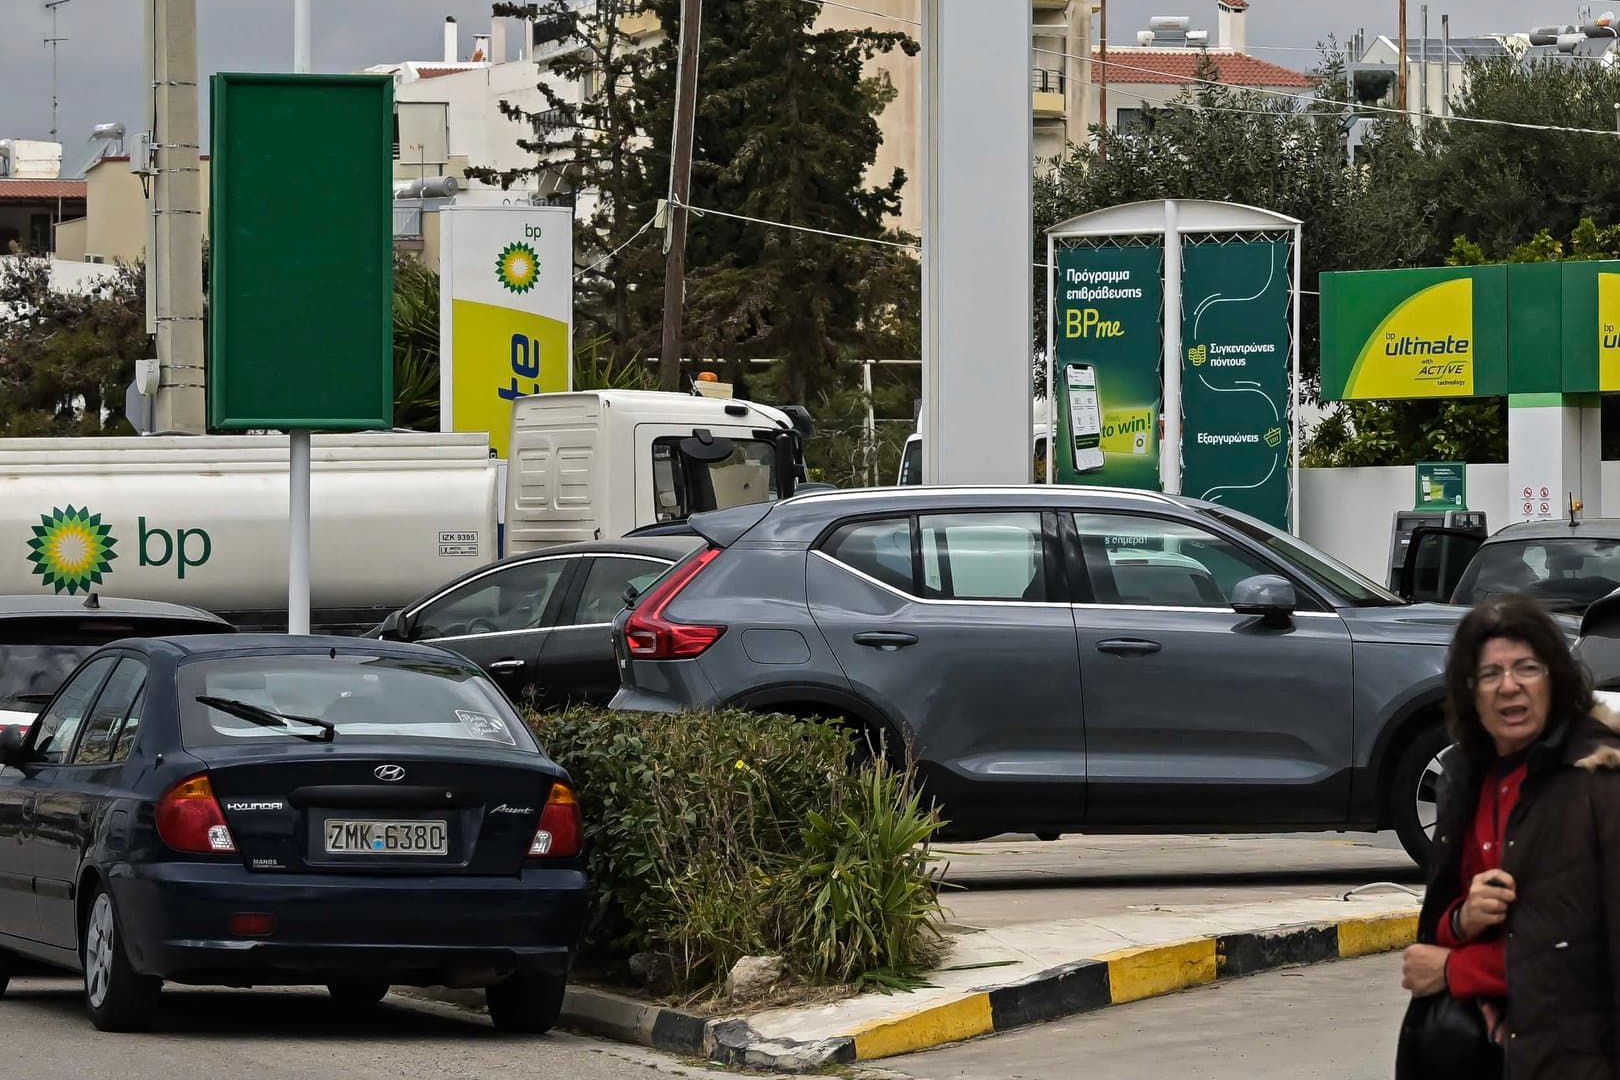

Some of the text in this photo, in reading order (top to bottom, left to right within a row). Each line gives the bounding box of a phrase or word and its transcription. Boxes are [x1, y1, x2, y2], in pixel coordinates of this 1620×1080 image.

[525, 224, 542, 241] bp
[1066, 268, 1130, 284] Πρόγραμμα
[1066, 286, 1142, 302] επιβράβευσης
[1065, 308, 1124, 339] BPme
[1210, 342, 1275, 355] Συγκεντρώνεις
[1385, 335, 1469, 356] ultimate
[498, 333, 539, 400] te
[1210, 356, 1246, 367] πόντους
[1418, 364, 1464, 375] ACTIVE
[1102, 412, 1151, 438] to win!
[1197, 432, 1259, 445] Εξαργυρώνεις
[137, 516, 212, 579] bp
[227, 802, 283, 811] HYUNDAI
[331, 824, 443, 850] ZMK-6380
